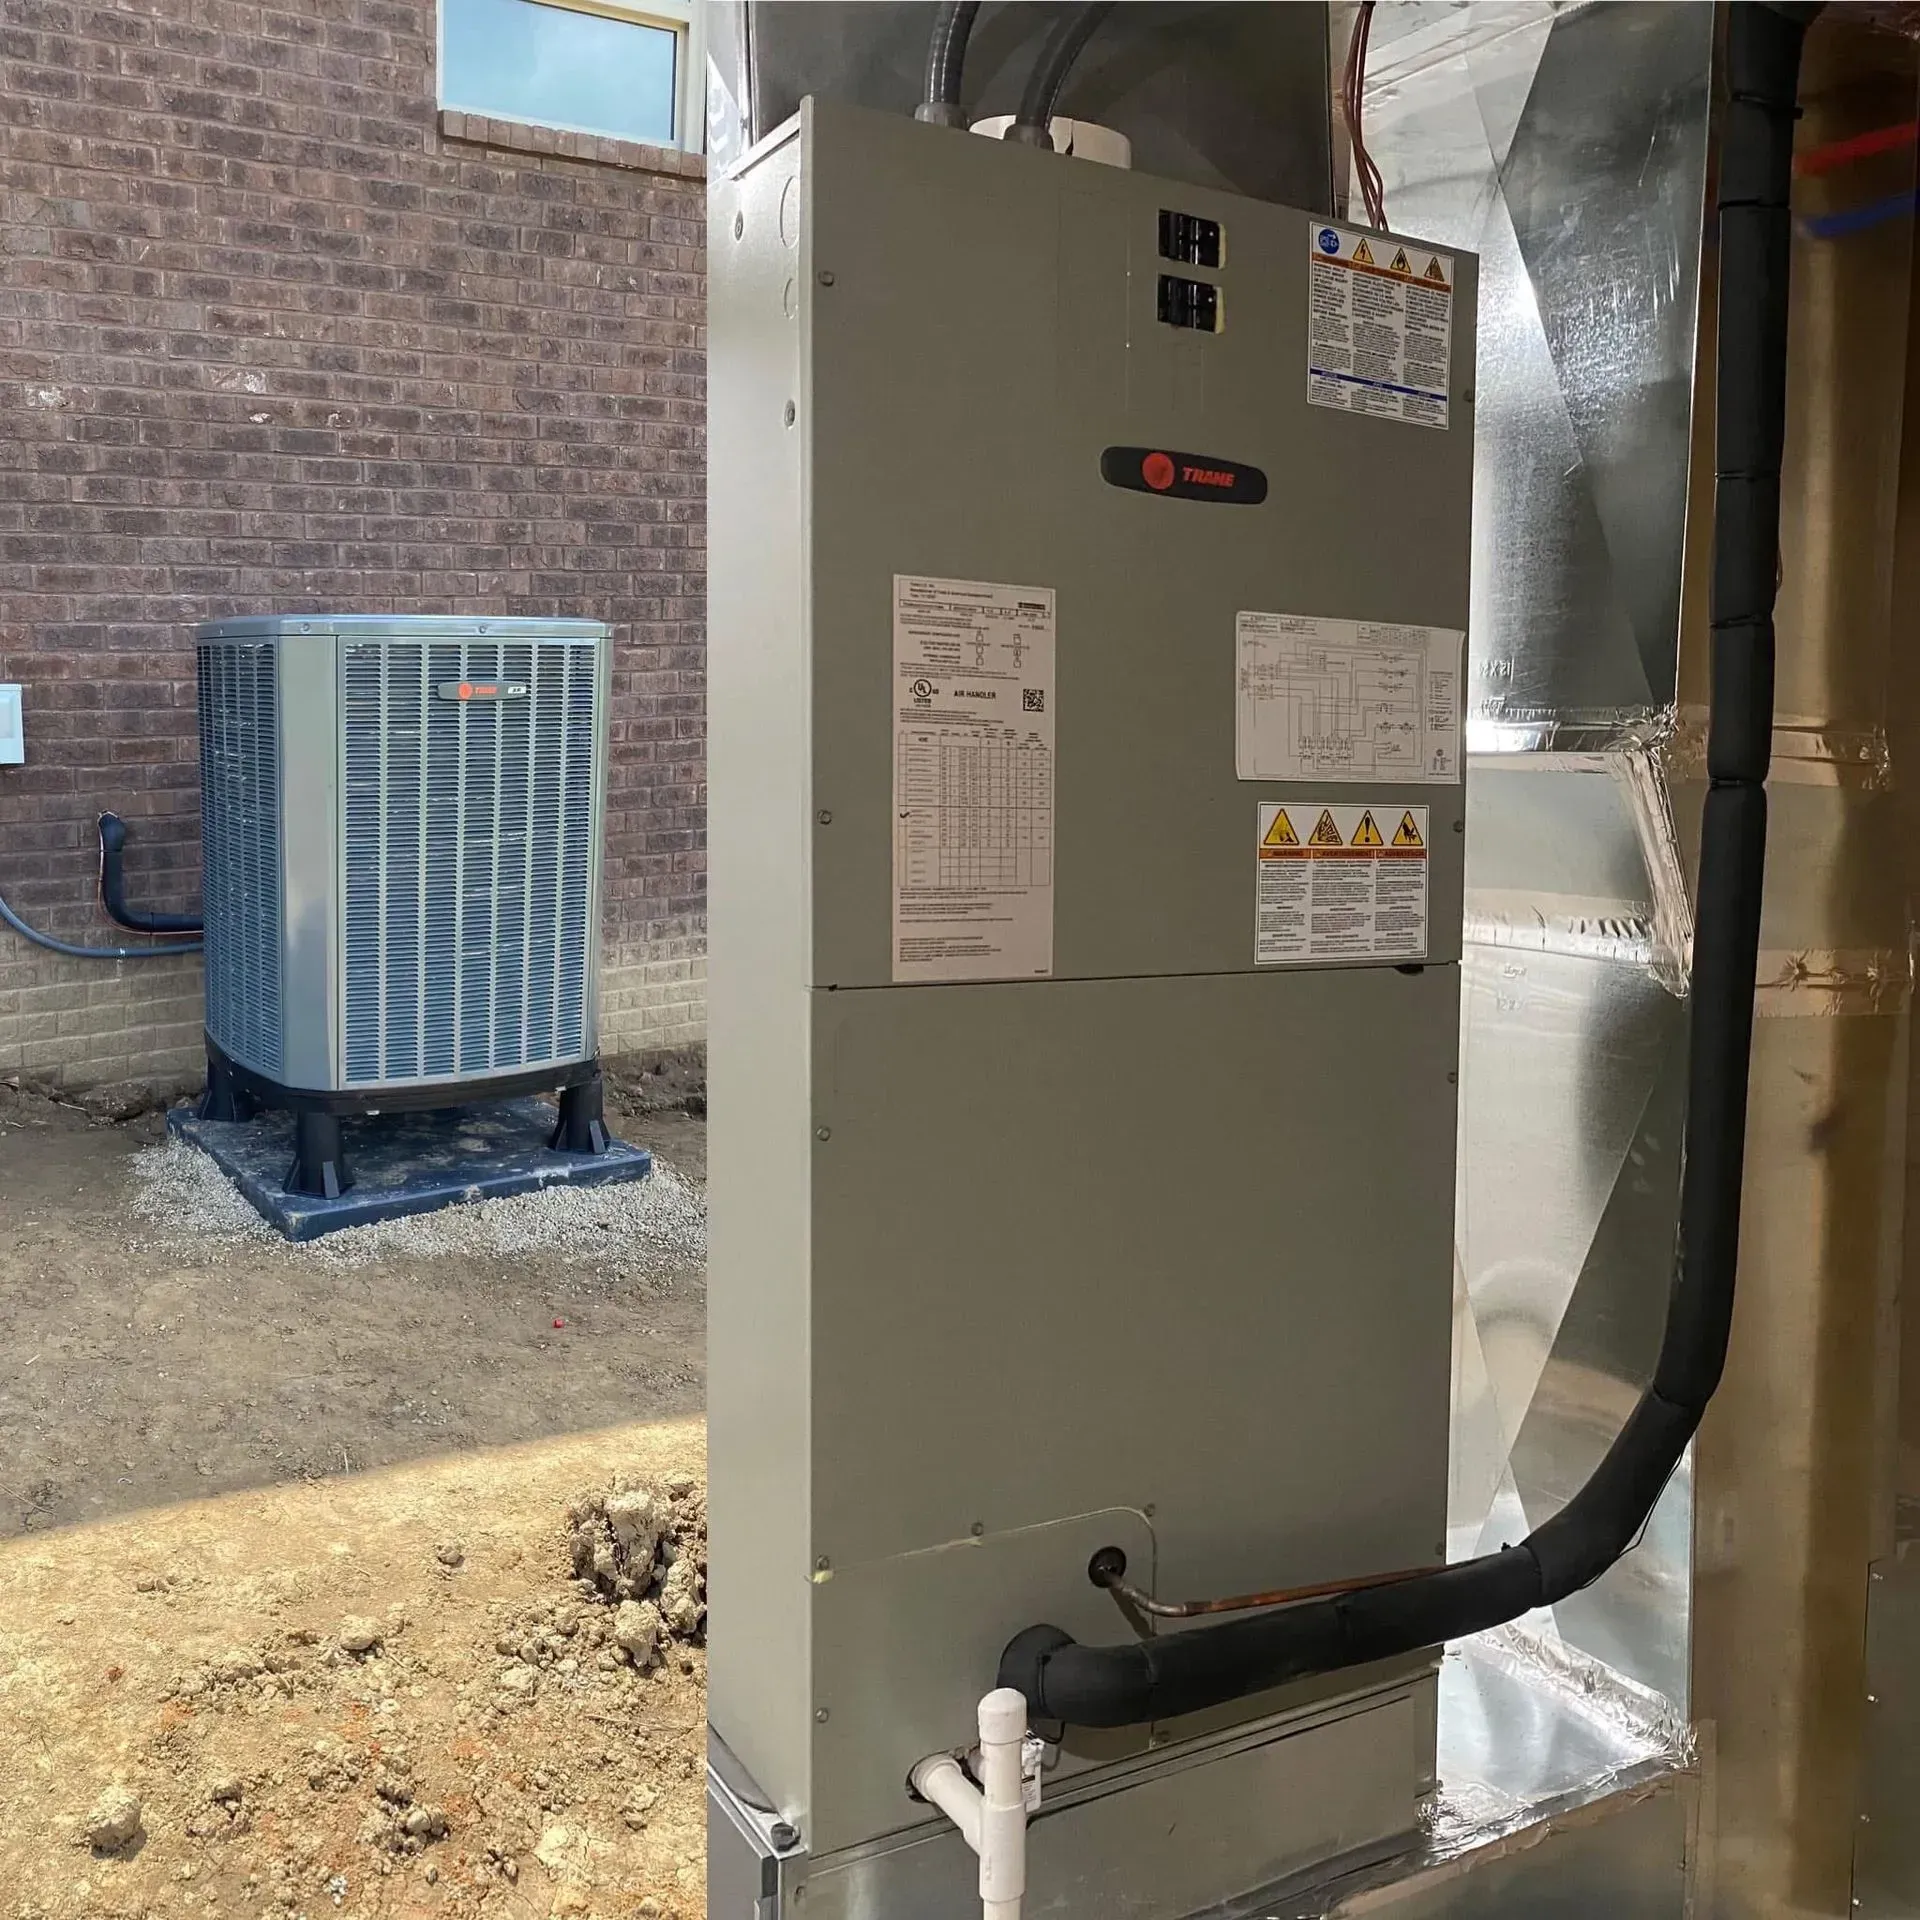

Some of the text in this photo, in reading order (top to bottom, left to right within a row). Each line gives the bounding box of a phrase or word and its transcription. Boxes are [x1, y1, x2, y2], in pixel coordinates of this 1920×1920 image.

[1183, 467, 1235, 488] TRANE
[954, 690, 996, 700] AIR HANDLER
